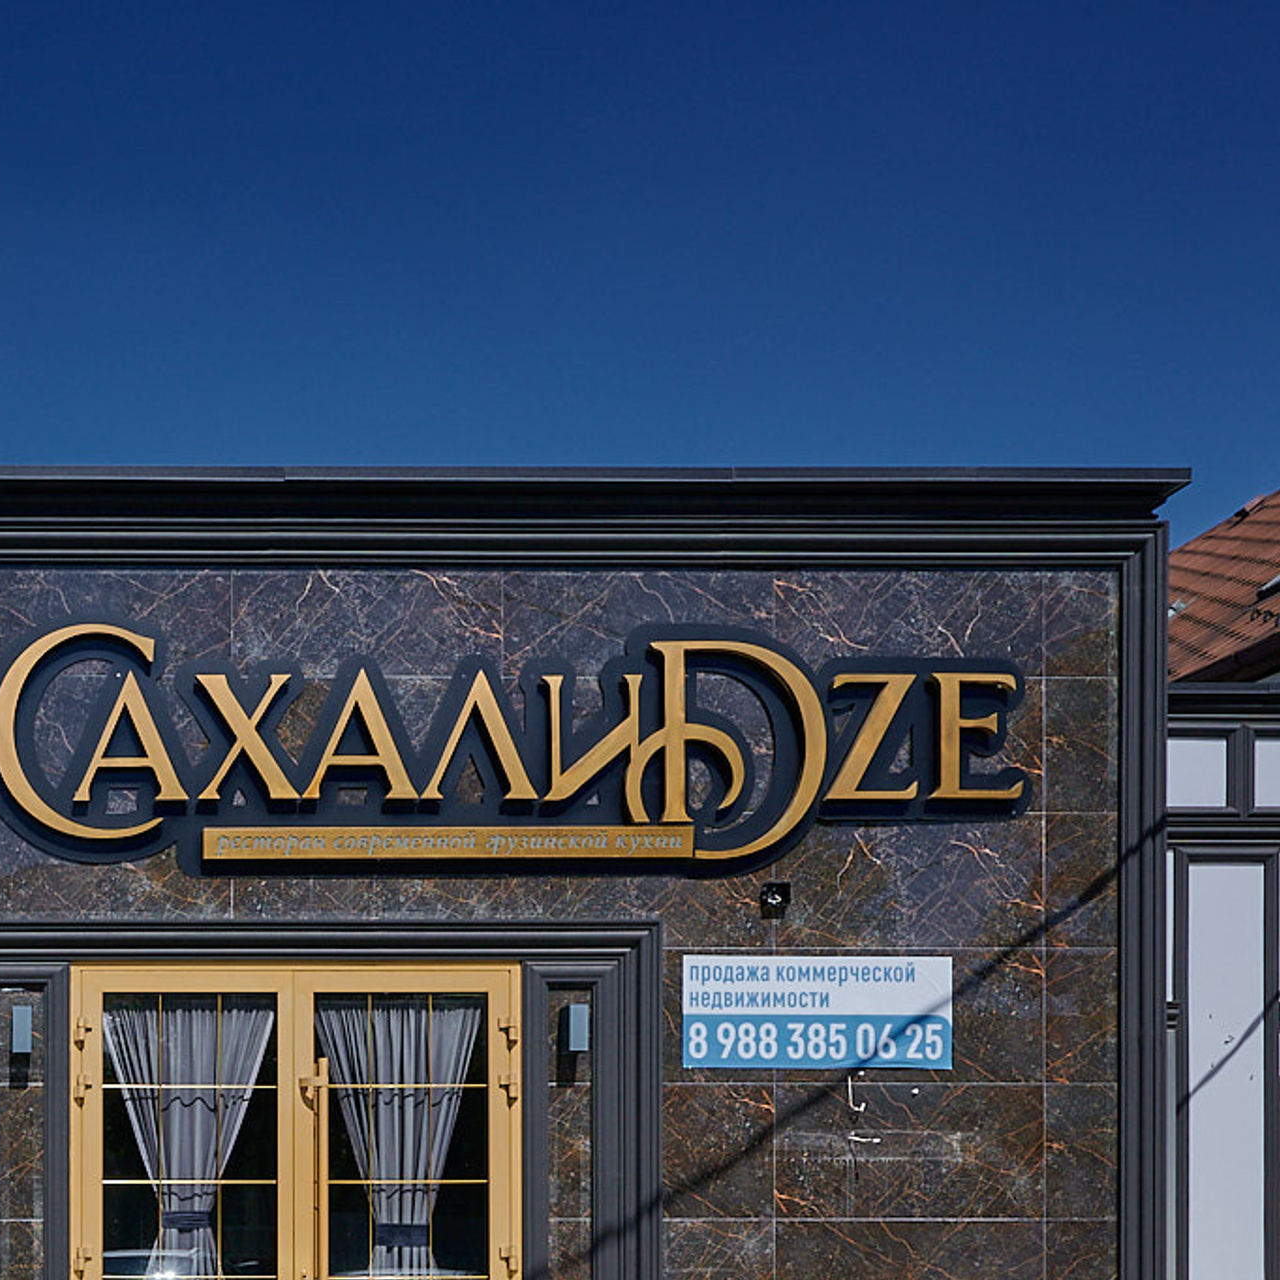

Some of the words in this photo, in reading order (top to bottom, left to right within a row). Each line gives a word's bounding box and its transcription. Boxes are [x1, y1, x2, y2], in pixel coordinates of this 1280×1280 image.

[217, 834, 325, 856] ресторан
[333, 830, 476, 856] современной
[485, 830, 608, 856] грузинской
[615, 833, 683, 855] кухни
[689, 964, 770, 985] продажа
[776, 962, 916, 986] коммерческой
[689, 991, 830, 1009] недвижимости
[688, 1022, 708, 1060] 8
[716, 1022, 778, 1060] 988
[786, 1022, 847, 1060] 385
[856, 1022, 897, 1061] 06
[904, 1022, 943, 1061] 25
